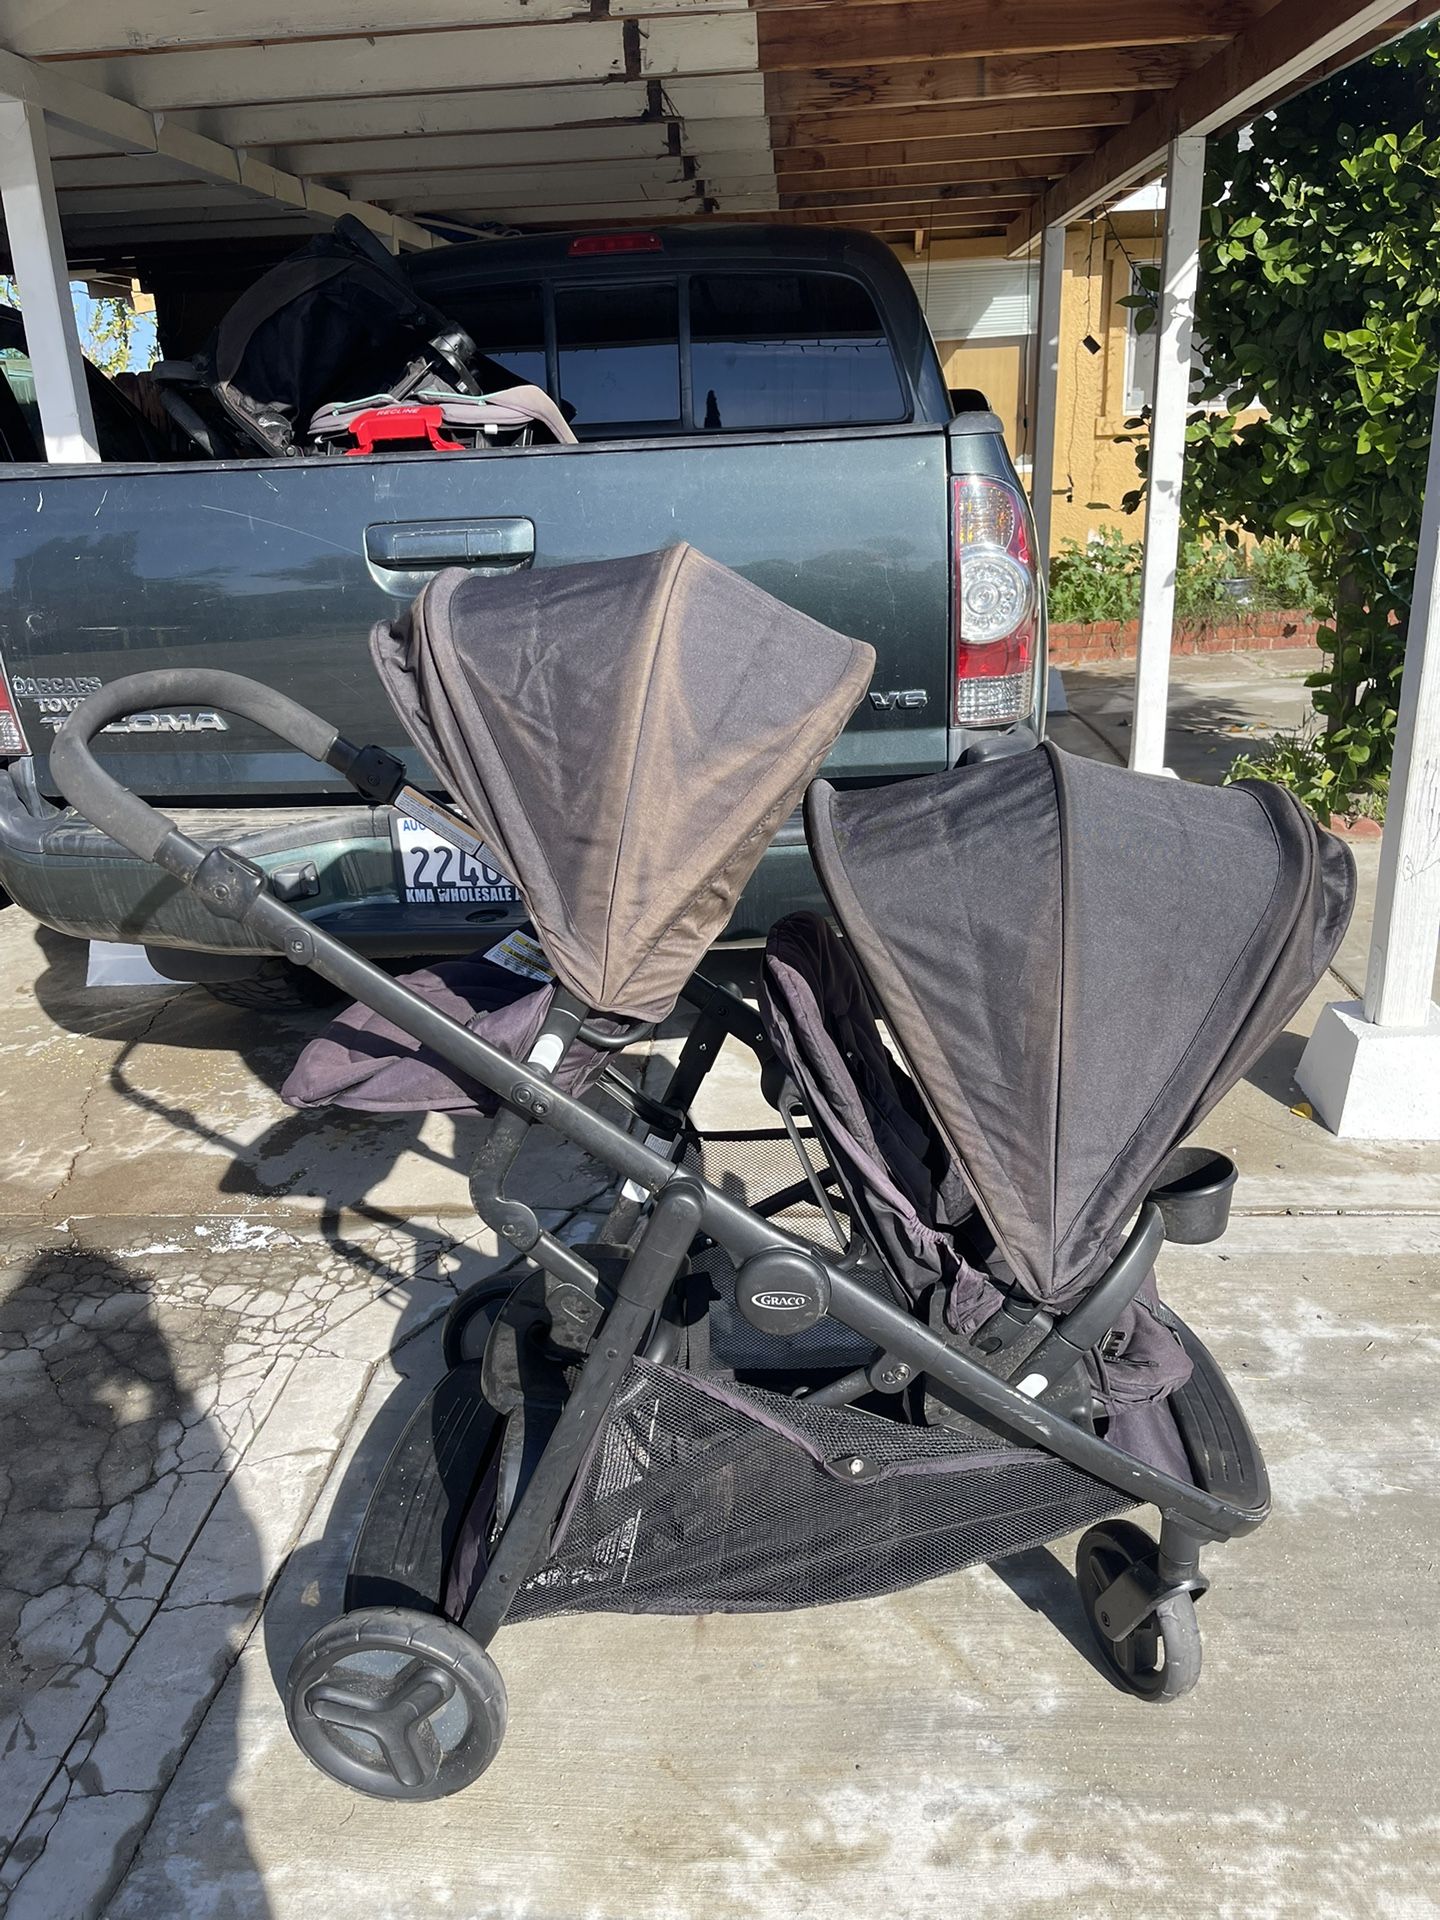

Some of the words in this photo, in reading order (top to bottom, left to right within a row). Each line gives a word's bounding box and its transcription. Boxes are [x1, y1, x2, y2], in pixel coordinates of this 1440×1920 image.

[376, 408, 420, 416] RECLINE
[869, 689, 928, 710] V6
[405, 888, 435, 903] KMA
[438, 886, 512, 902] WHOLESALE
[760, 1295, 806, 1306] GRACO
